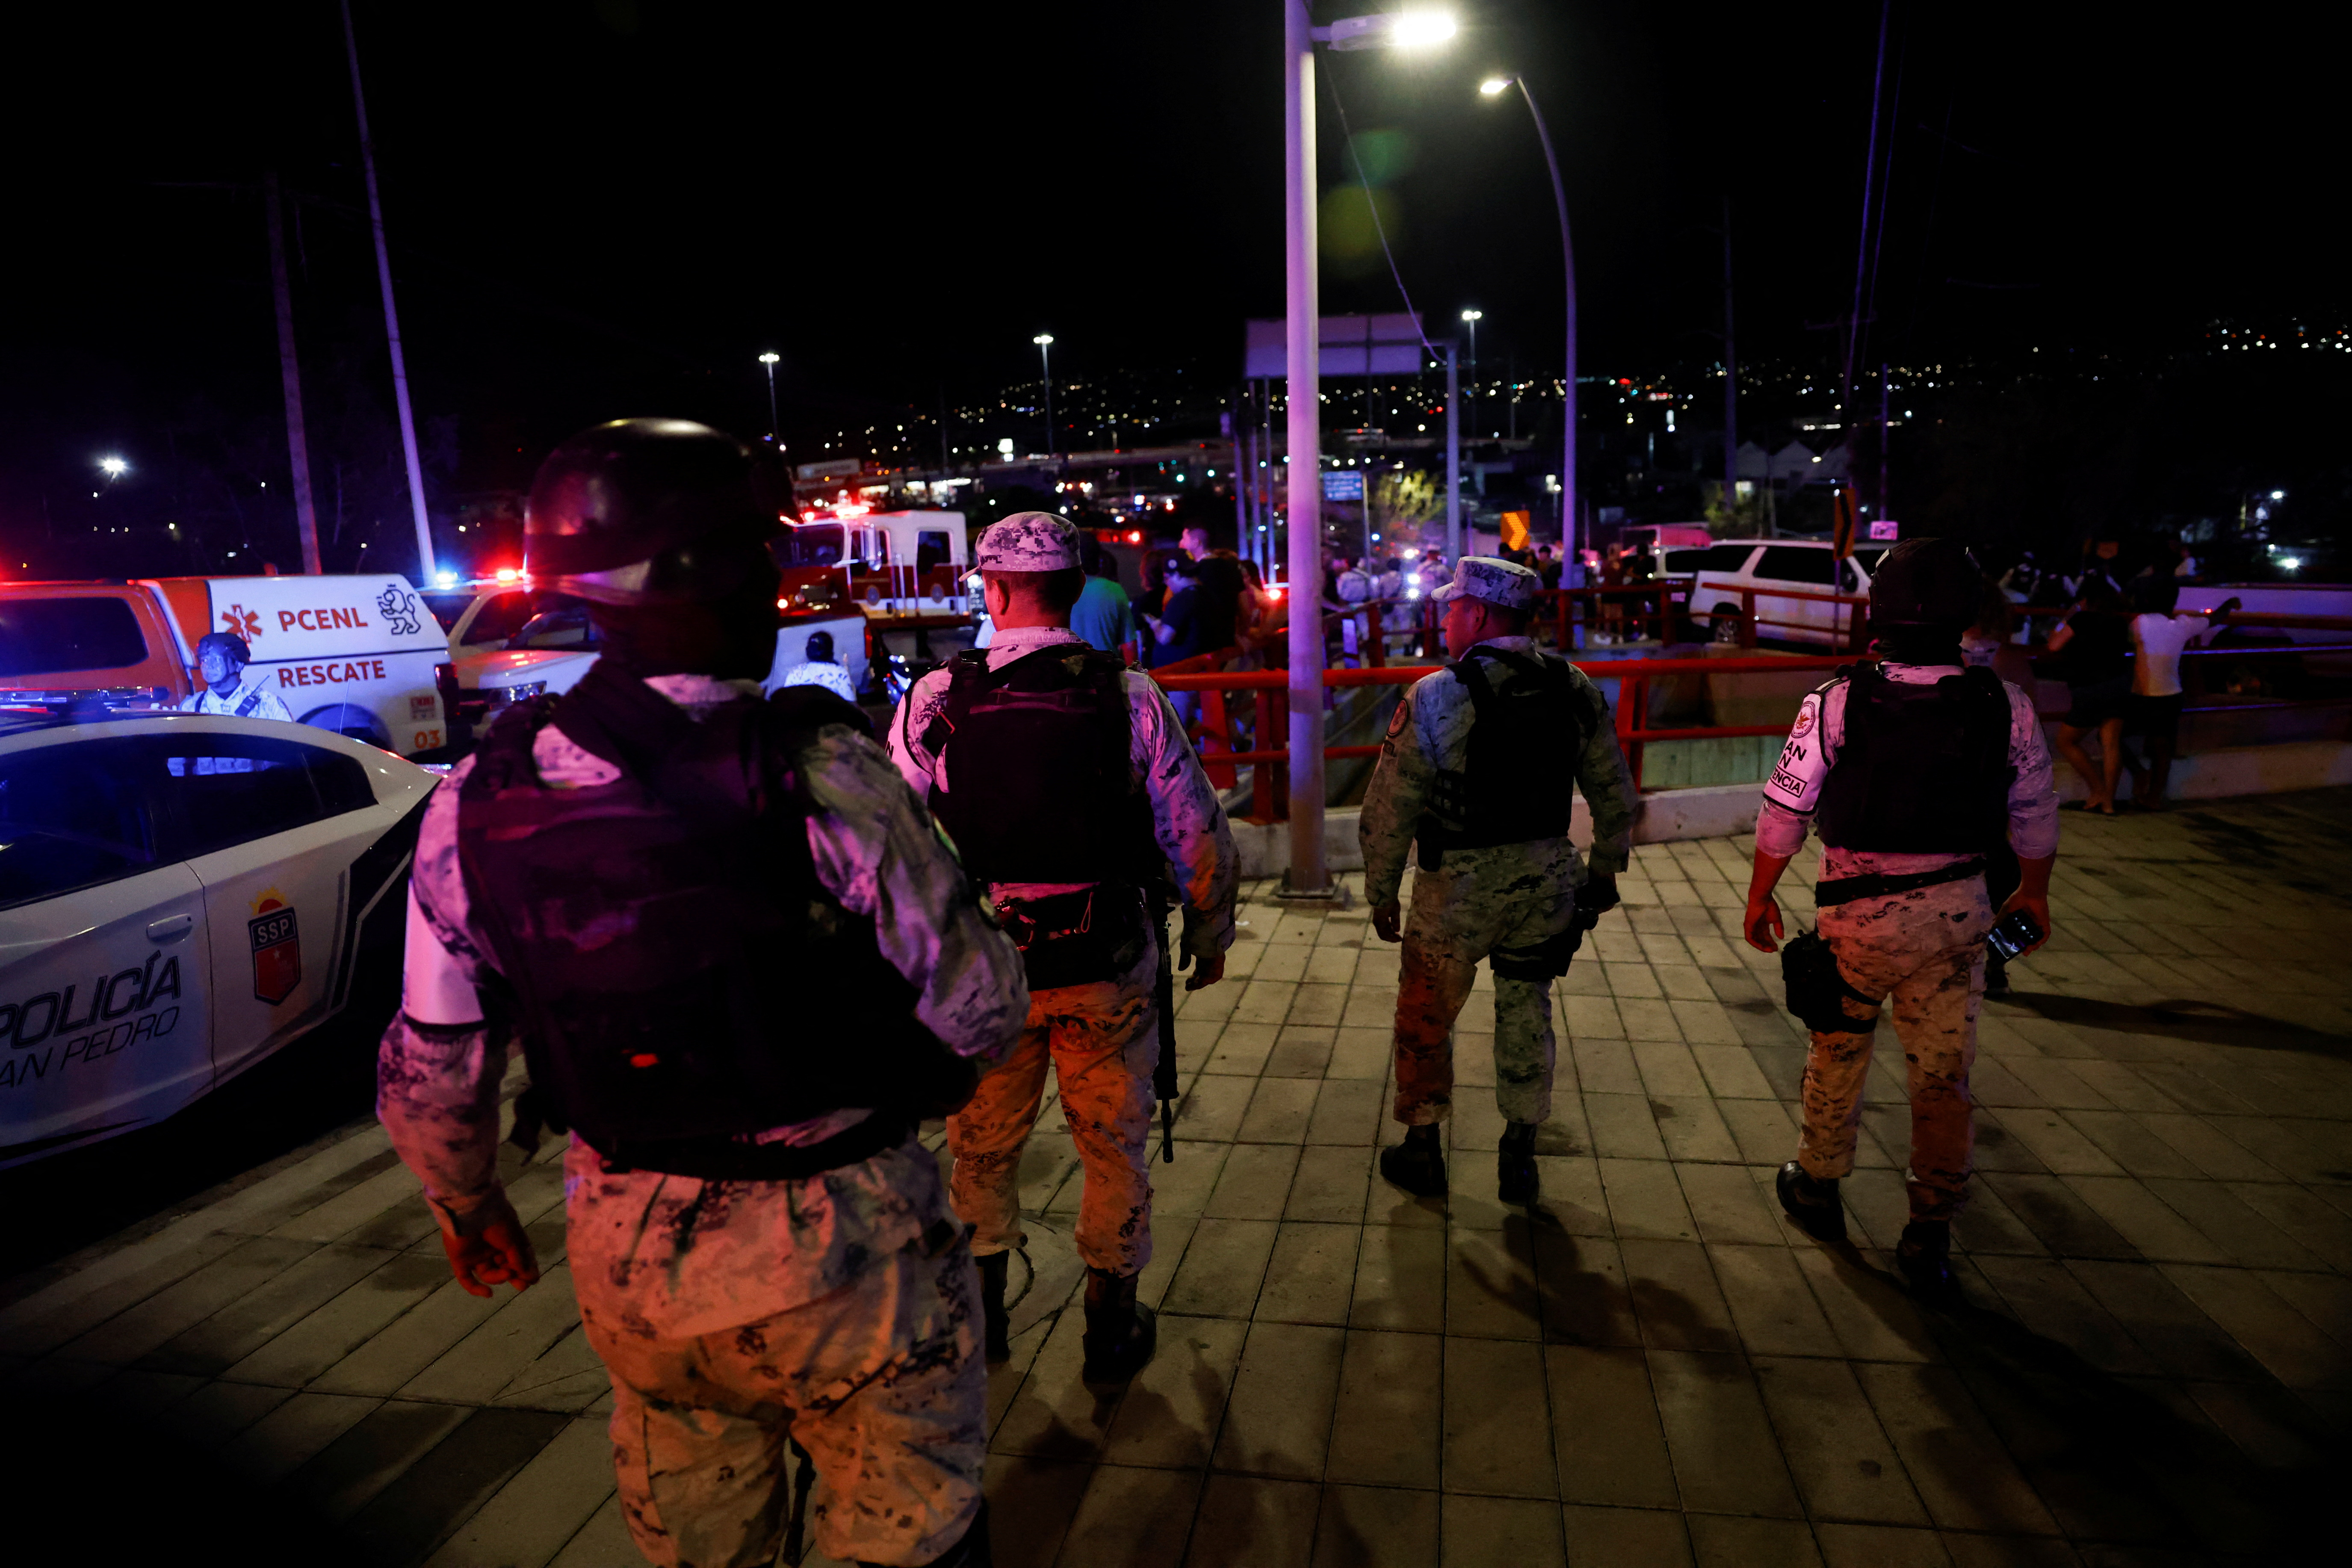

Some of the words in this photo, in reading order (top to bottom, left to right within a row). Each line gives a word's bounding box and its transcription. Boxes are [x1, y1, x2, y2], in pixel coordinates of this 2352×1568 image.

[278, 608, 368, 631] PCENL
[278, 661, 386, 688] RESCATE
[414, 729, 440, 749] 03
[1785, 741, 1807, 761] AN
[1779, 753, 1791, 769] N
[1772, 768, 1800, 794] ENCIA
[257, 918, 289, 943] SSP
[0, 1047, 53, 1087] AN
[59, 1006, 180, 1070] PEDRO
